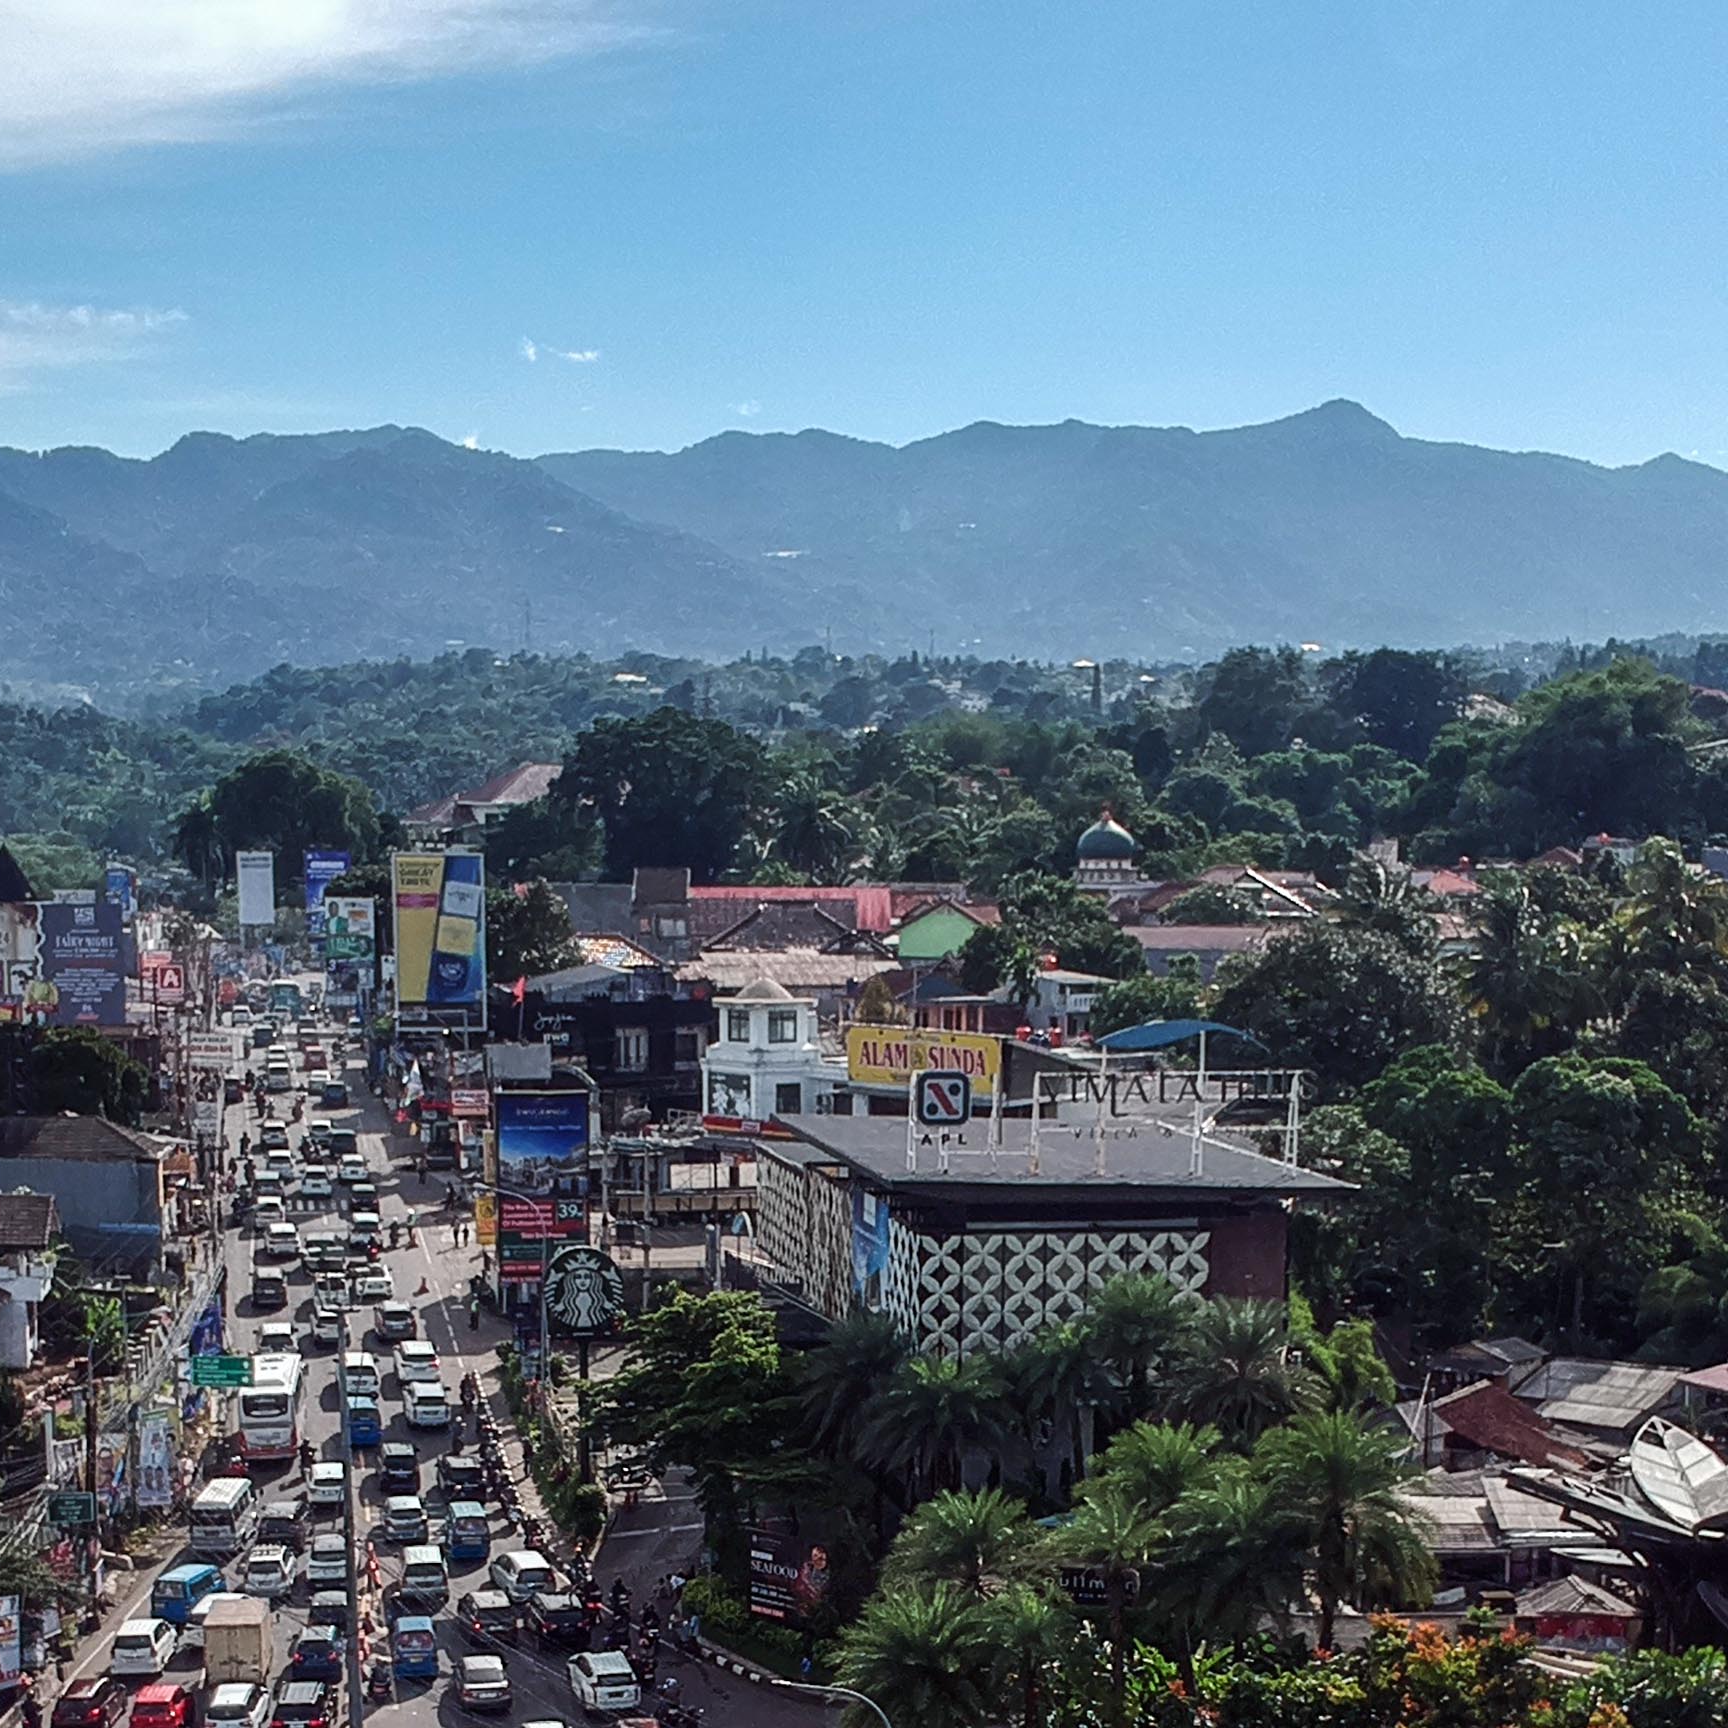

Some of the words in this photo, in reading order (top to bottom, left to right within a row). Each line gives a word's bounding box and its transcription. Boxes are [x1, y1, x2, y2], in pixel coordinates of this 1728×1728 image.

[859, 1040, 908, 1069] ALAM
[927, 1045, 986, 1076] SUNDA
[921, 1134, 967, 1145] APL
[751, 1560, 798, 1579] SEAFOOD
